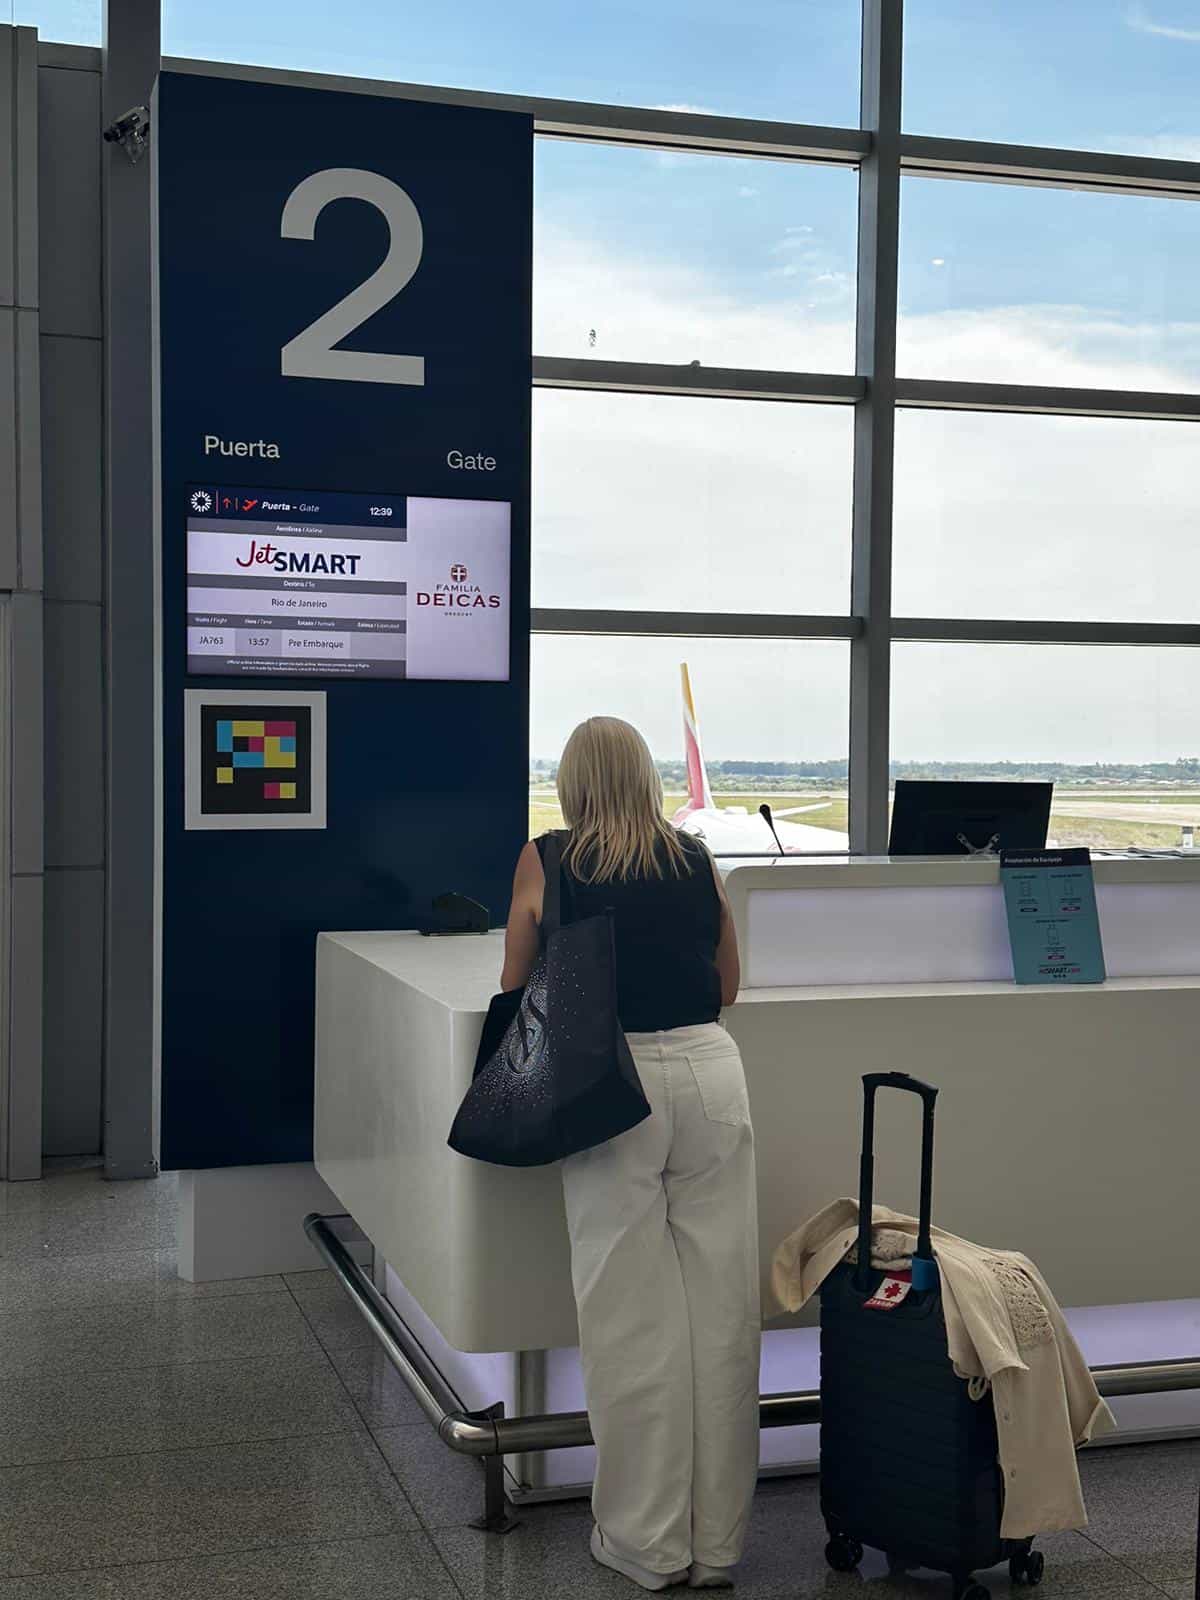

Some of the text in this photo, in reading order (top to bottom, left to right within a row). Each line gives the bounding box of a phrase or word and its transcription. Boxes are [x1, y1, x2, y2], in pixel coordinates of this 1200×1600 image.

[281, 167, 425, 386] 2
[204, 435, 281, 460] Puerta
[446, 449, 497, 472] Gate
[262, 501, 291, 511] Puerta
[299, 503, 320, 513] Gate
[369, 506, 393, 517] 12:39
[436, 583, 481, 593] FAMILIA
[271, 598, 328, 609] Rio de Janeiro
[416, 592, 501, 609] DEICAS
[199, 636, 225, 646] JA763
[248, 638, 270, 647] 13:57
[288, 638, 344, 650] Pre Embarque
